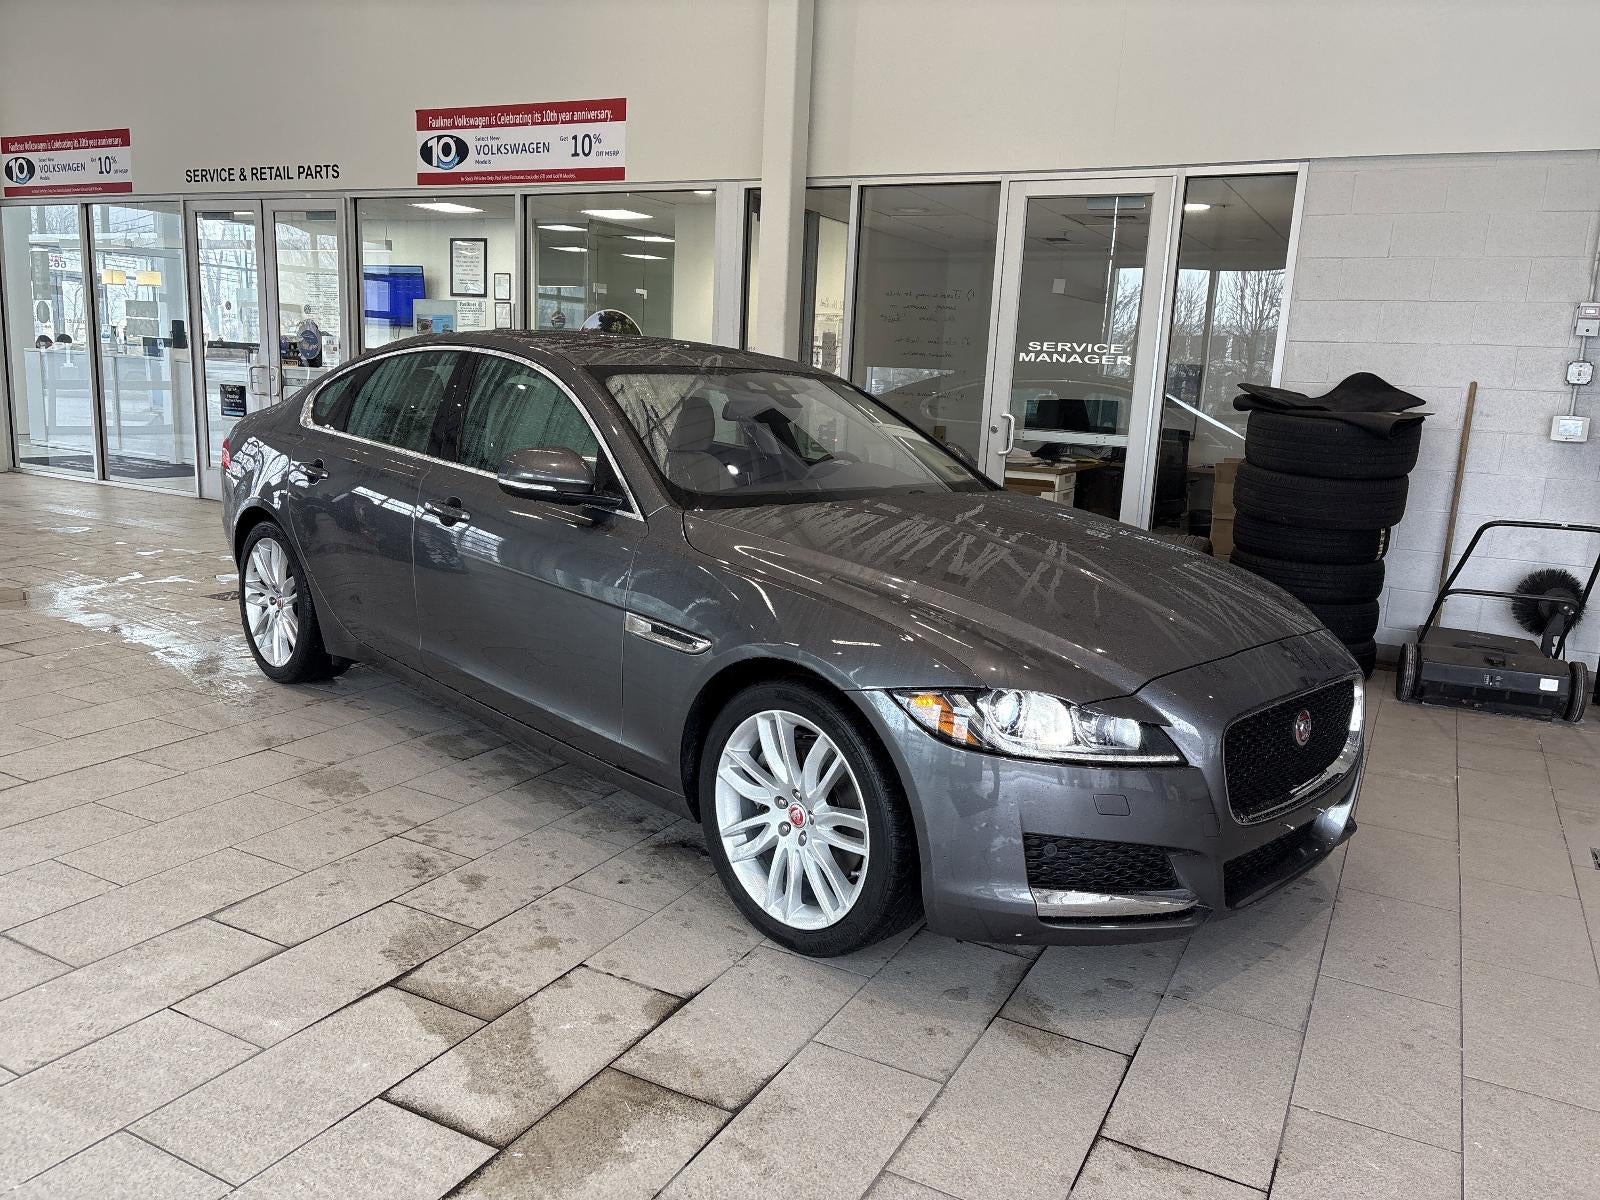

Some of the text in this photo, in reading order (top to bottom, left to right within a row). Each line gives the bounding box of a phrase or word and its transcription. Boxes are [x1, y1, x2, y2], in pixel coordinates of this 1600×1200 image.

[428, 115, 454, 128] Faulkner
[454, 115, 490, 129] Volkswagen
[490, 114, 496, 124] is
[497, 112, 532, 126] Celebrating
[543, 110, 558, 122] 10th
[559, 112, 572, 124] year
[574, 108, 613, 121] anniversary.
[475, 142, 550, 156] VOLKSWAGEN
[39, 162, 86, 173] VOLKSWAGEN
[185, 164, 340, 183] SERVICE & RETAIL PARTS
[1028, 341, 1125, 354] SERVICE
[1018, 352, 1132, 366] MANAGER
